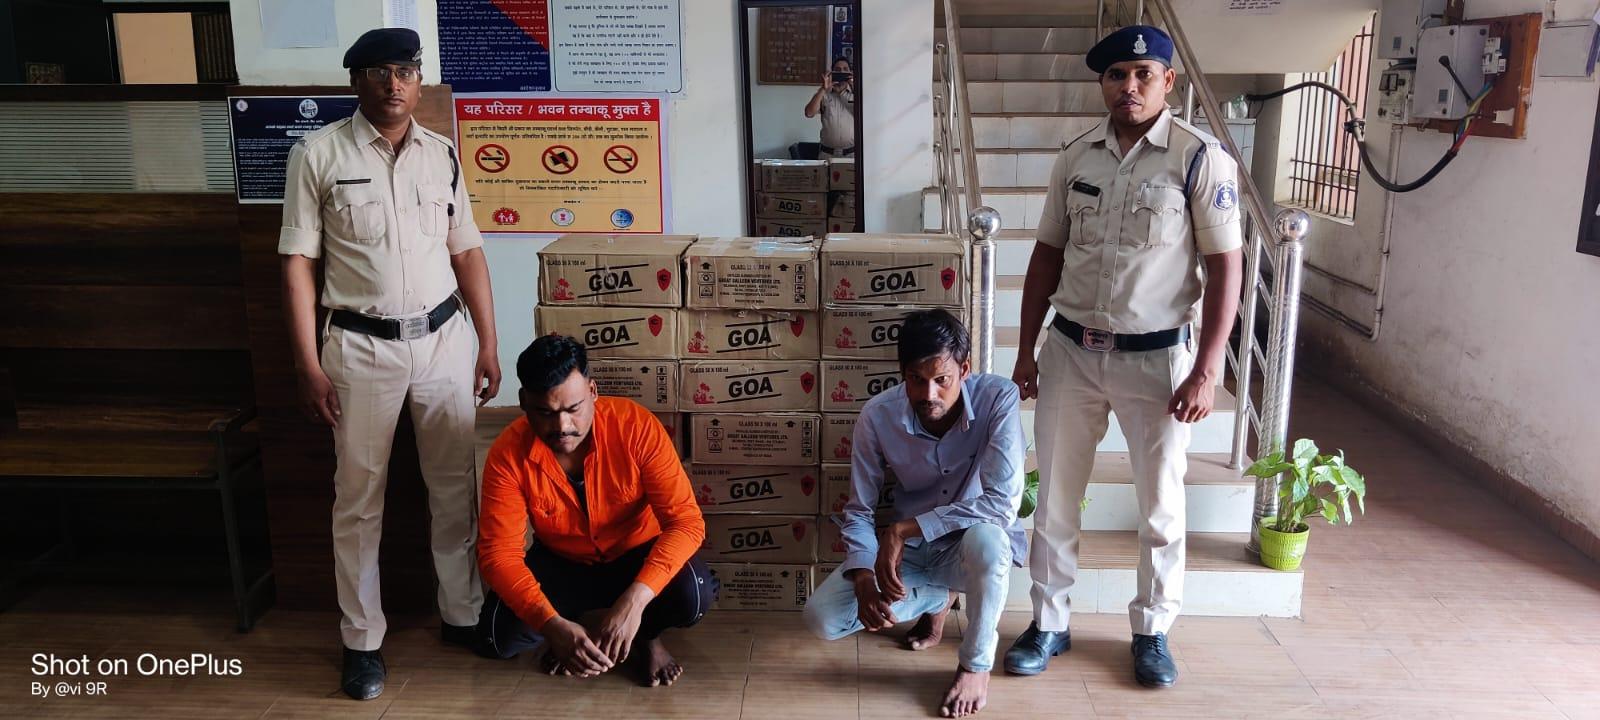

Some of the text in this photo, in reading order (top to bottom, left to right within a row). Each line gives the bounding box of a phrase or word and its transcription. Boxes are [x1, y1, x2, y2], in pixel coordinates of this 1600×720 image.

[464, 104, 482, 115] यह
[485, 100, 523, 115] परिसर
[538, 104, 565, 115] भवन
[569, 104, 611, 119] तम्बाकू
[613, 104, 639, 119] मुक्त
[642, 101, 651, 116] है
[589, 271, 634, 292] GOA
[870, 271, 917, 293] GOA
[584, 325, 630, 346] GOA
[727, 326, 772, 348] GOA
[871, 324, 901, 343] GO
[728, 376, 773, 398] GOA
[867, 377, 899, 396] GO
[730, 480, 774, 499] GOA
[730, 530, 774, 549] GOA
